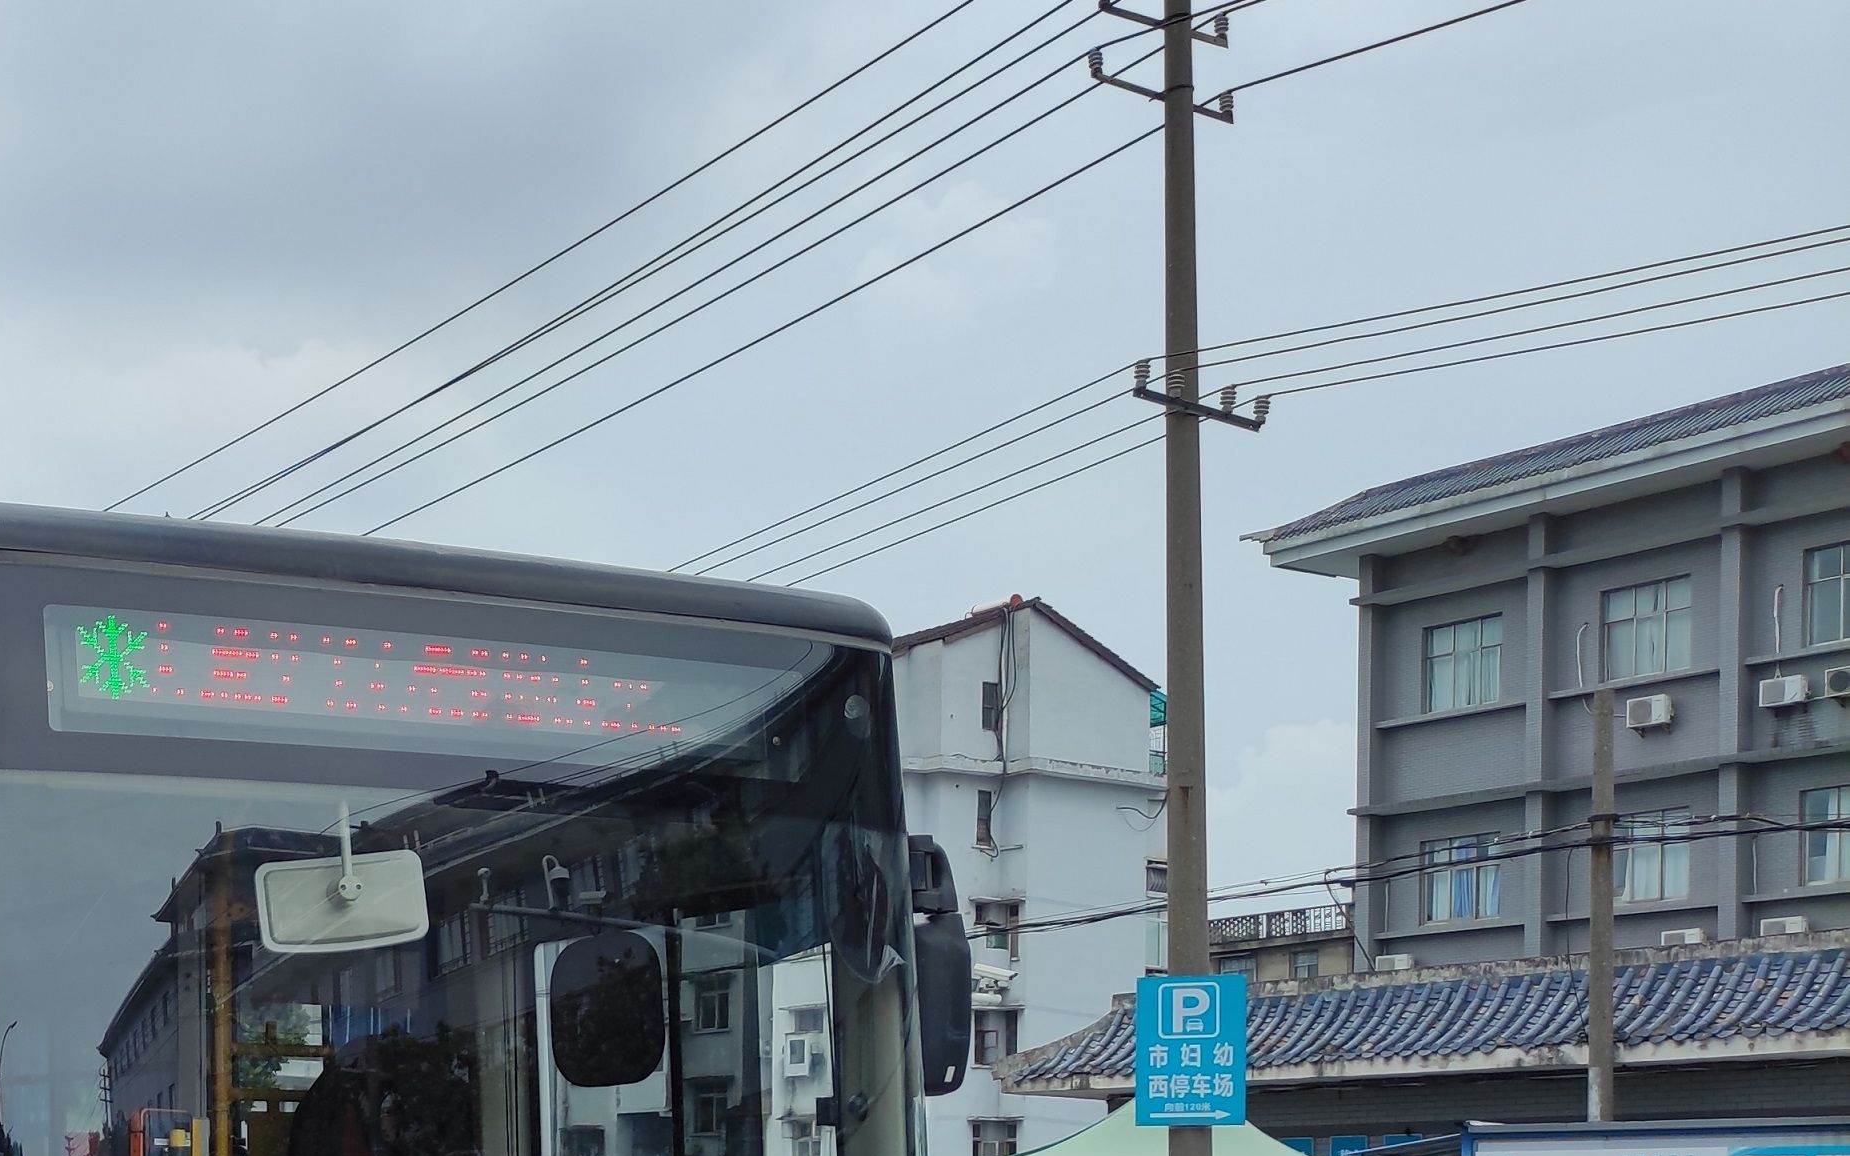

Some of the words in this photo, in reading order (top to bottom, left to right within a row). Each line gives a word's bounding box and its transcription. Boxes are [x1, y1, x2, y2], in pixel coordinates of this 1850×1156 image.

[1148, 1041, 1234, 1069] 市妇幼
[1148, 1073, 1234, 1099] 西停车场
[1164, 1102, 1212, 1112] 向前120米
